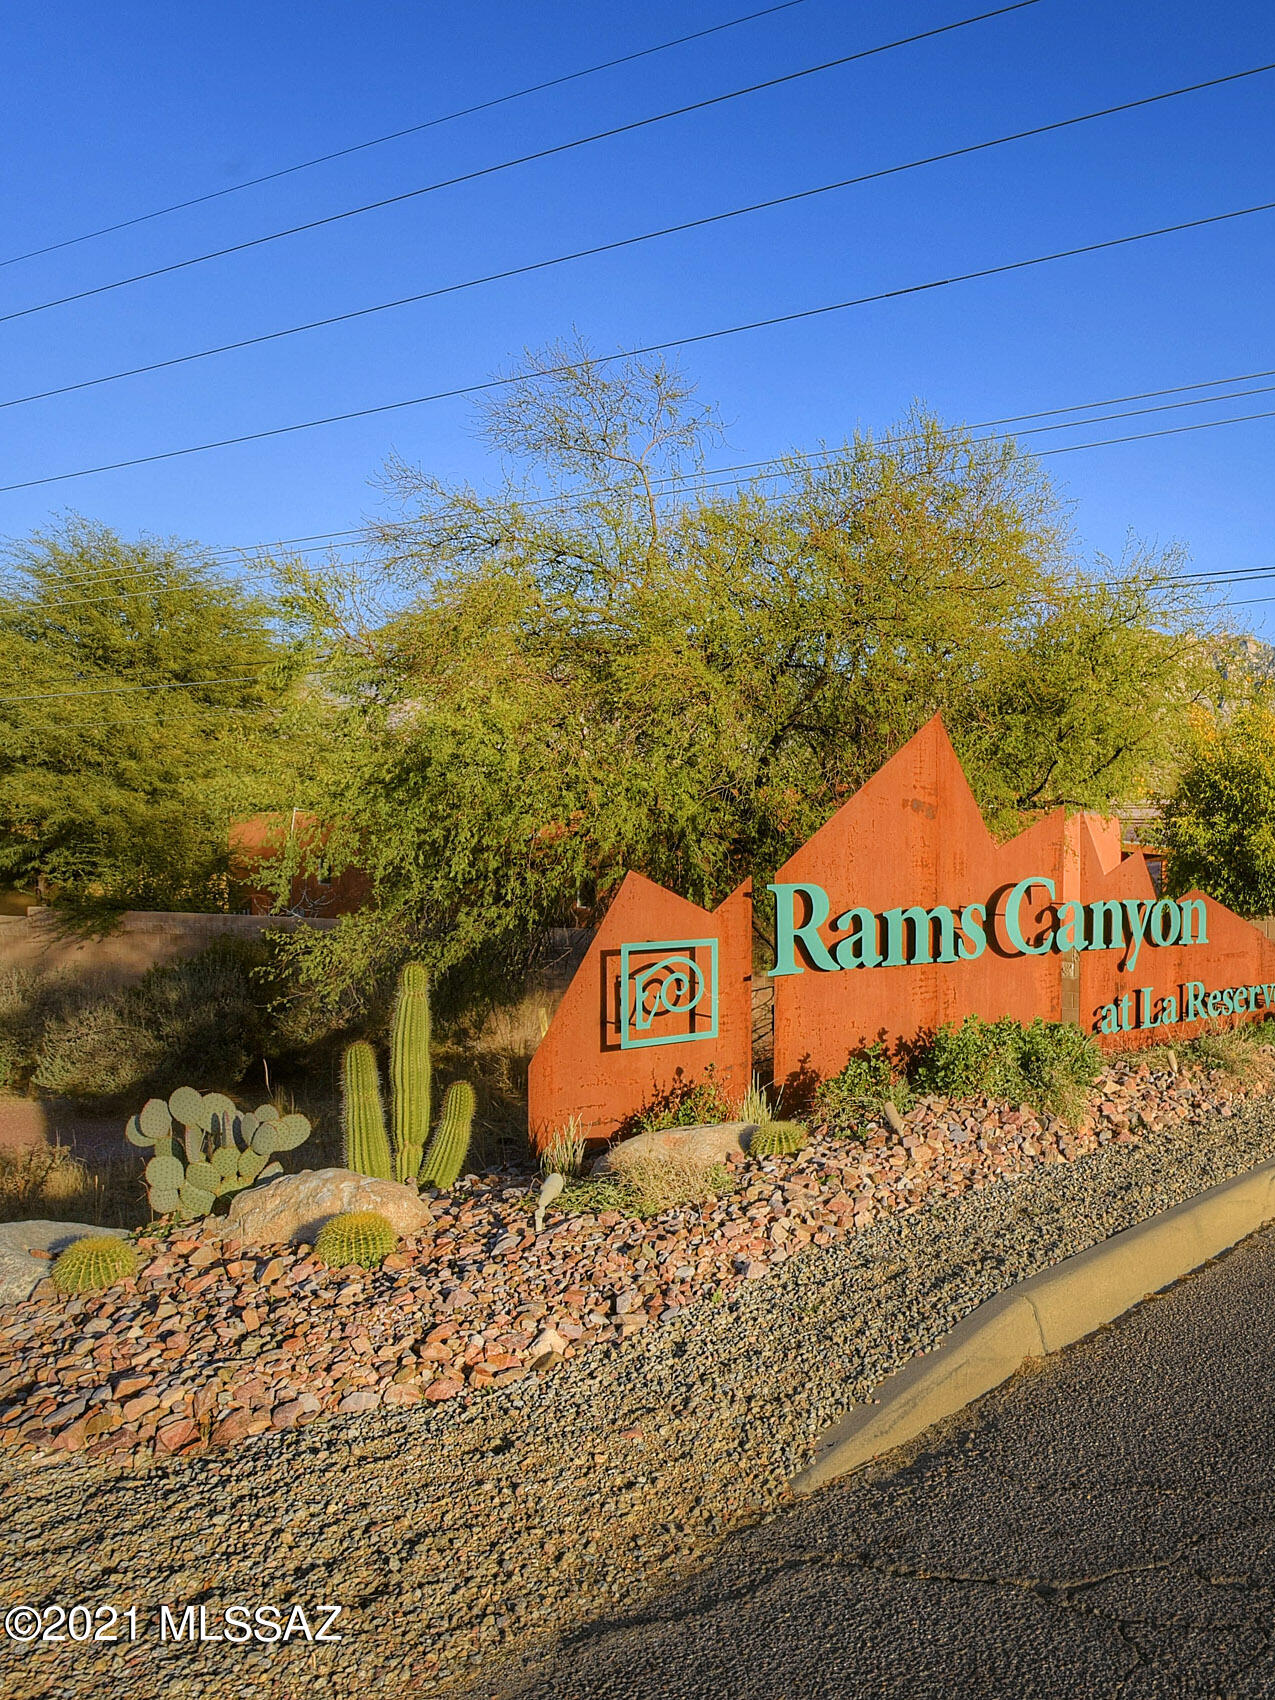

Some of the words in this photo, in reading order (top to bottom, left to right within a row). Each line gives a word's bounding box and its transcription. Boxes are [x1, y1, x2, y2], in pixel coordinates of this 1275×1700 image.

[767, 883, 987, 977] Rams
[1004, 876, 1209, 972] Canyon
[1100, 993, 1132, 1034] at
[1141, 986, 1180, 1028] La
